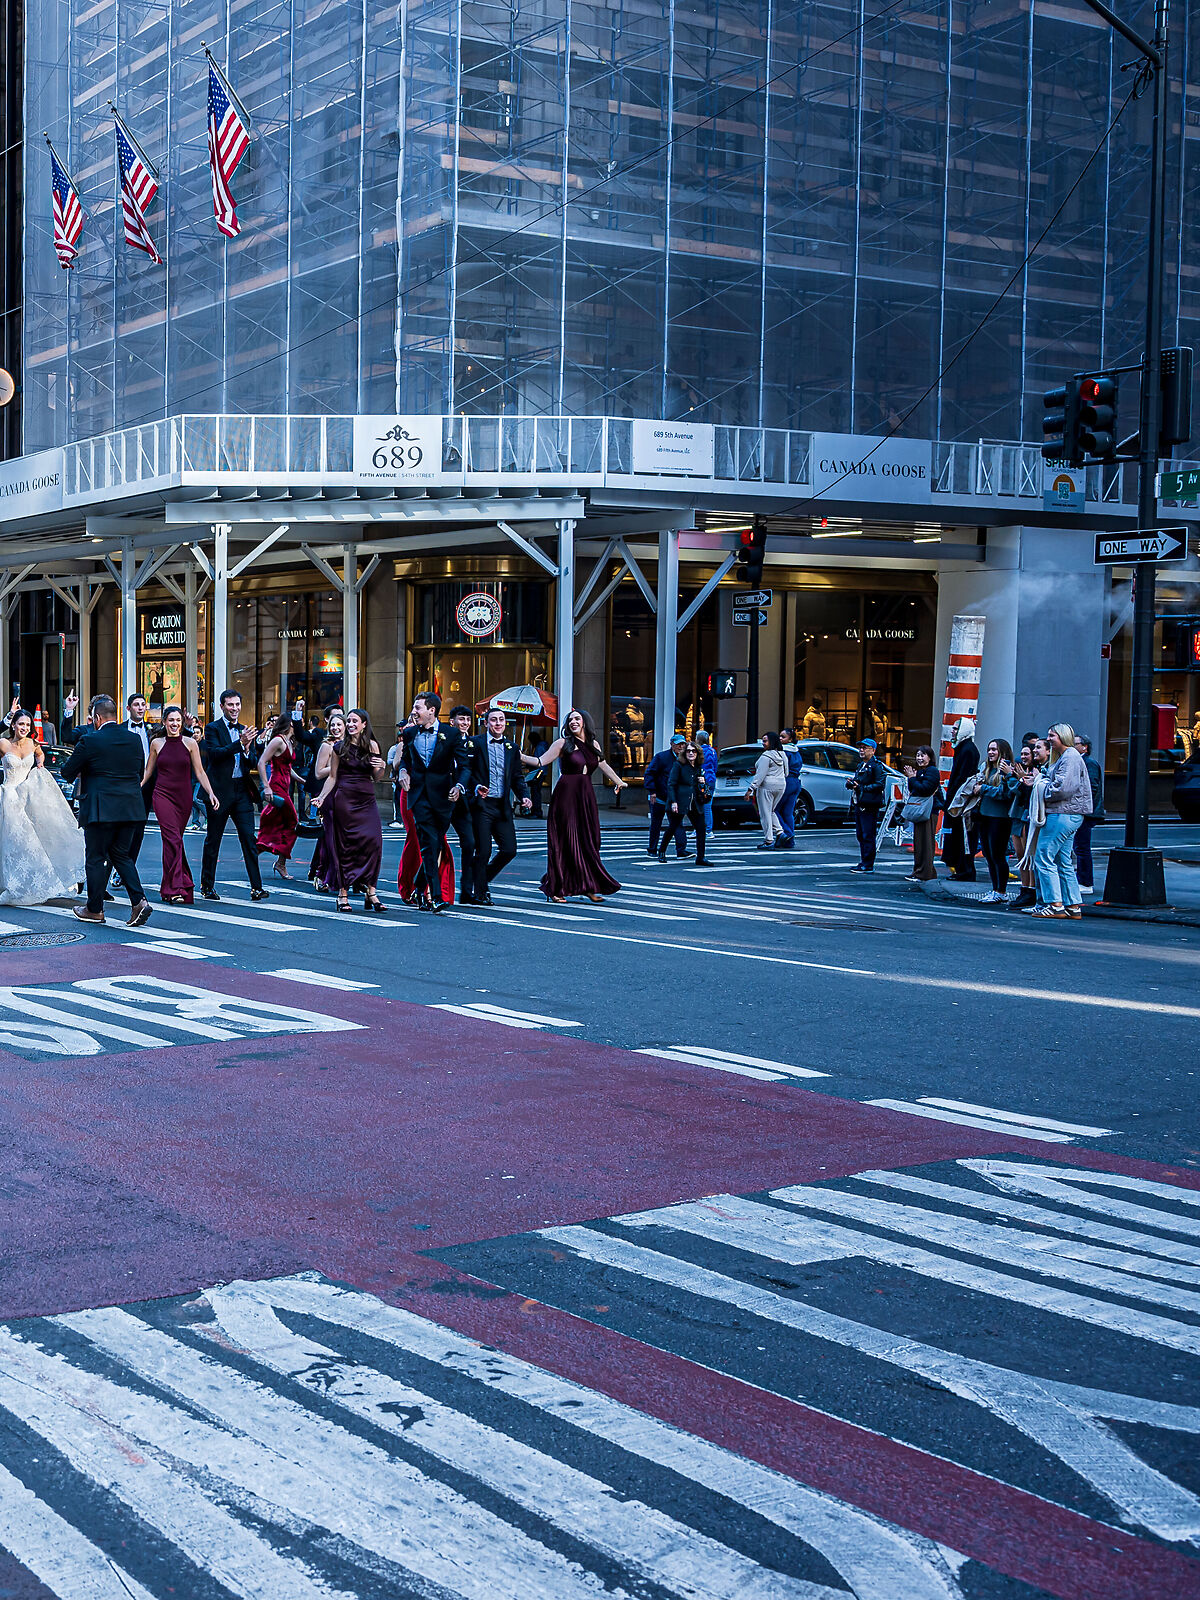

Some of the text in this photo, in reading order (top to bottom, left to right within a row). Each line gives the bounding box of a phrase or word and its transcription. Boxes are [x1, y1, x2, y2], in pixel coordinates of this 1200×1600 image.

[653, 430, 694, 440] 689 5th Avenue
[372, 446, 423, 469] 689
[819, 459, 926, 479] CANADA GOOSE
[0, 472, 60, 498] CANADA GOOSE
[1176, 473, 1198, 493] 5 Av
[1103, 538, 1168, 555] ONE WAY
[152, 614, 181, 629] CARLTON
[145, 630, 186, 645] FINE ARTS LTD
[278, 630, 303, 638] CANADA
[845, 629, 915, 639] CAADA GOOSE
